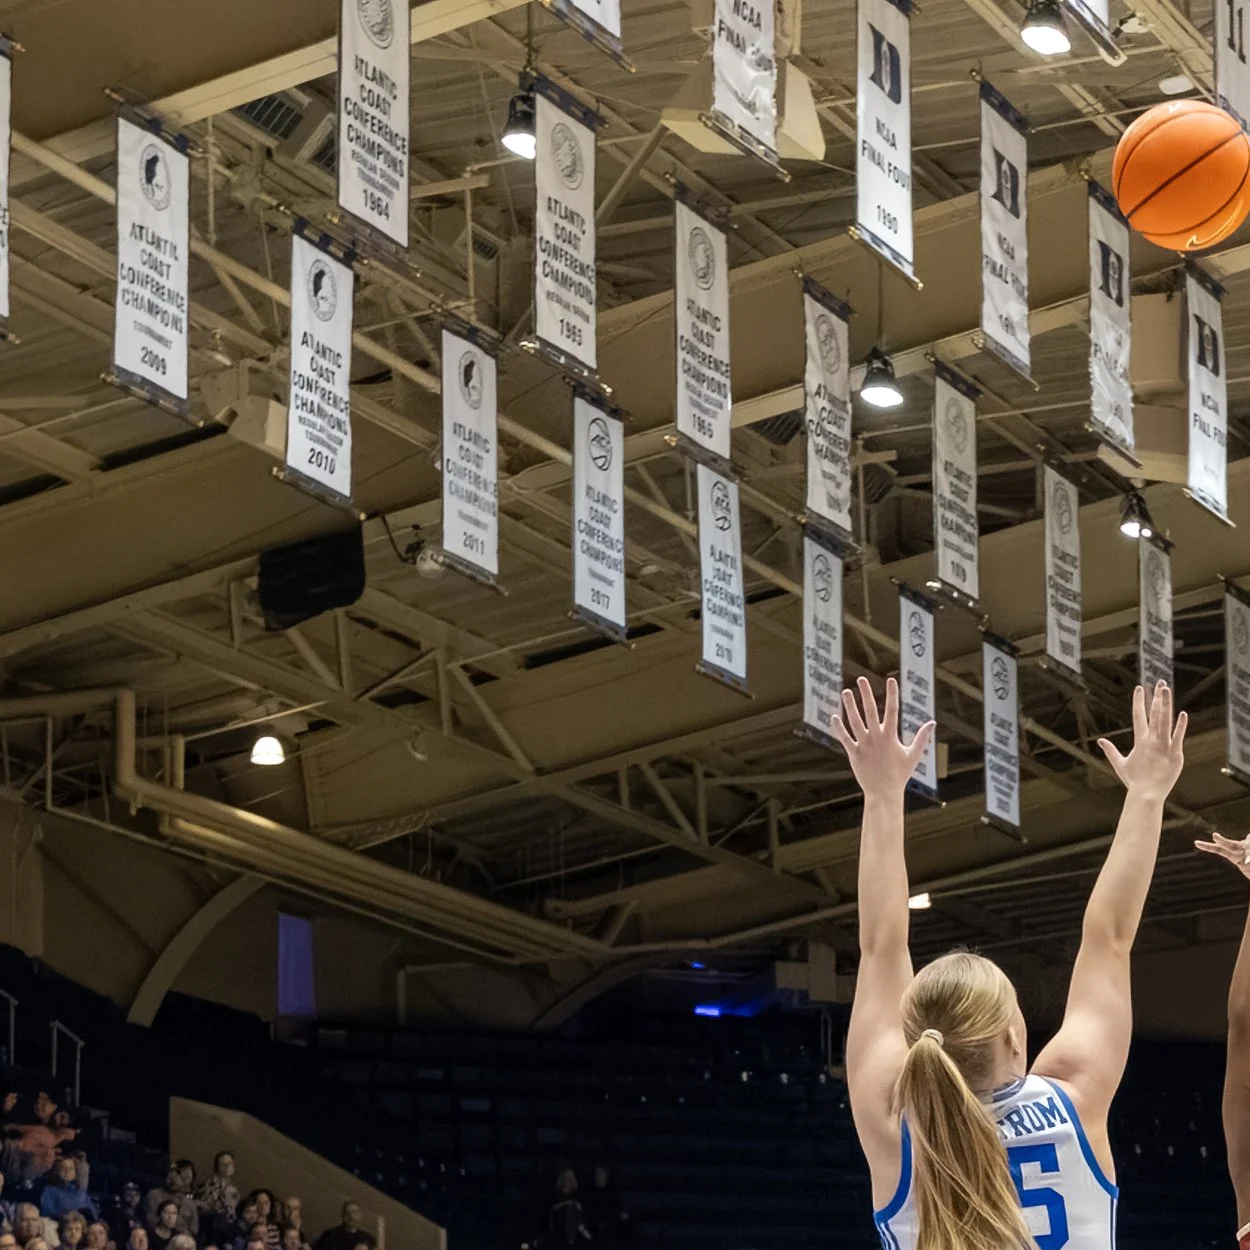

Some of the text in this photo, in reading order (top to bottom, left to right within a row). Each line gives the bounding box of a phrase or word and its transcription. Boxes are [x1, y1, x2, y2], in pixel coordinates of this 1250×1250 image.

[360, 84, 391, 118] COAST
[344, 97, 407, 155] CONFERENCE
[347, 124, 404, 178] CHAMPIONS
[362, 189, 390, 220] 1964
[547, 196, 586, 235] ATLANTIC
[554, 222, 581, 251] COAST
[140, 248, 171, 280] COAST
[539, 236, 595, 284] CONFERENCE
[120, 263, 186, 313] CONFERENCE
[140, 347, 167, 376] 2009
[301, 331, 342, 369] ATANTIC
[308, 448, 336, 475] 2010
